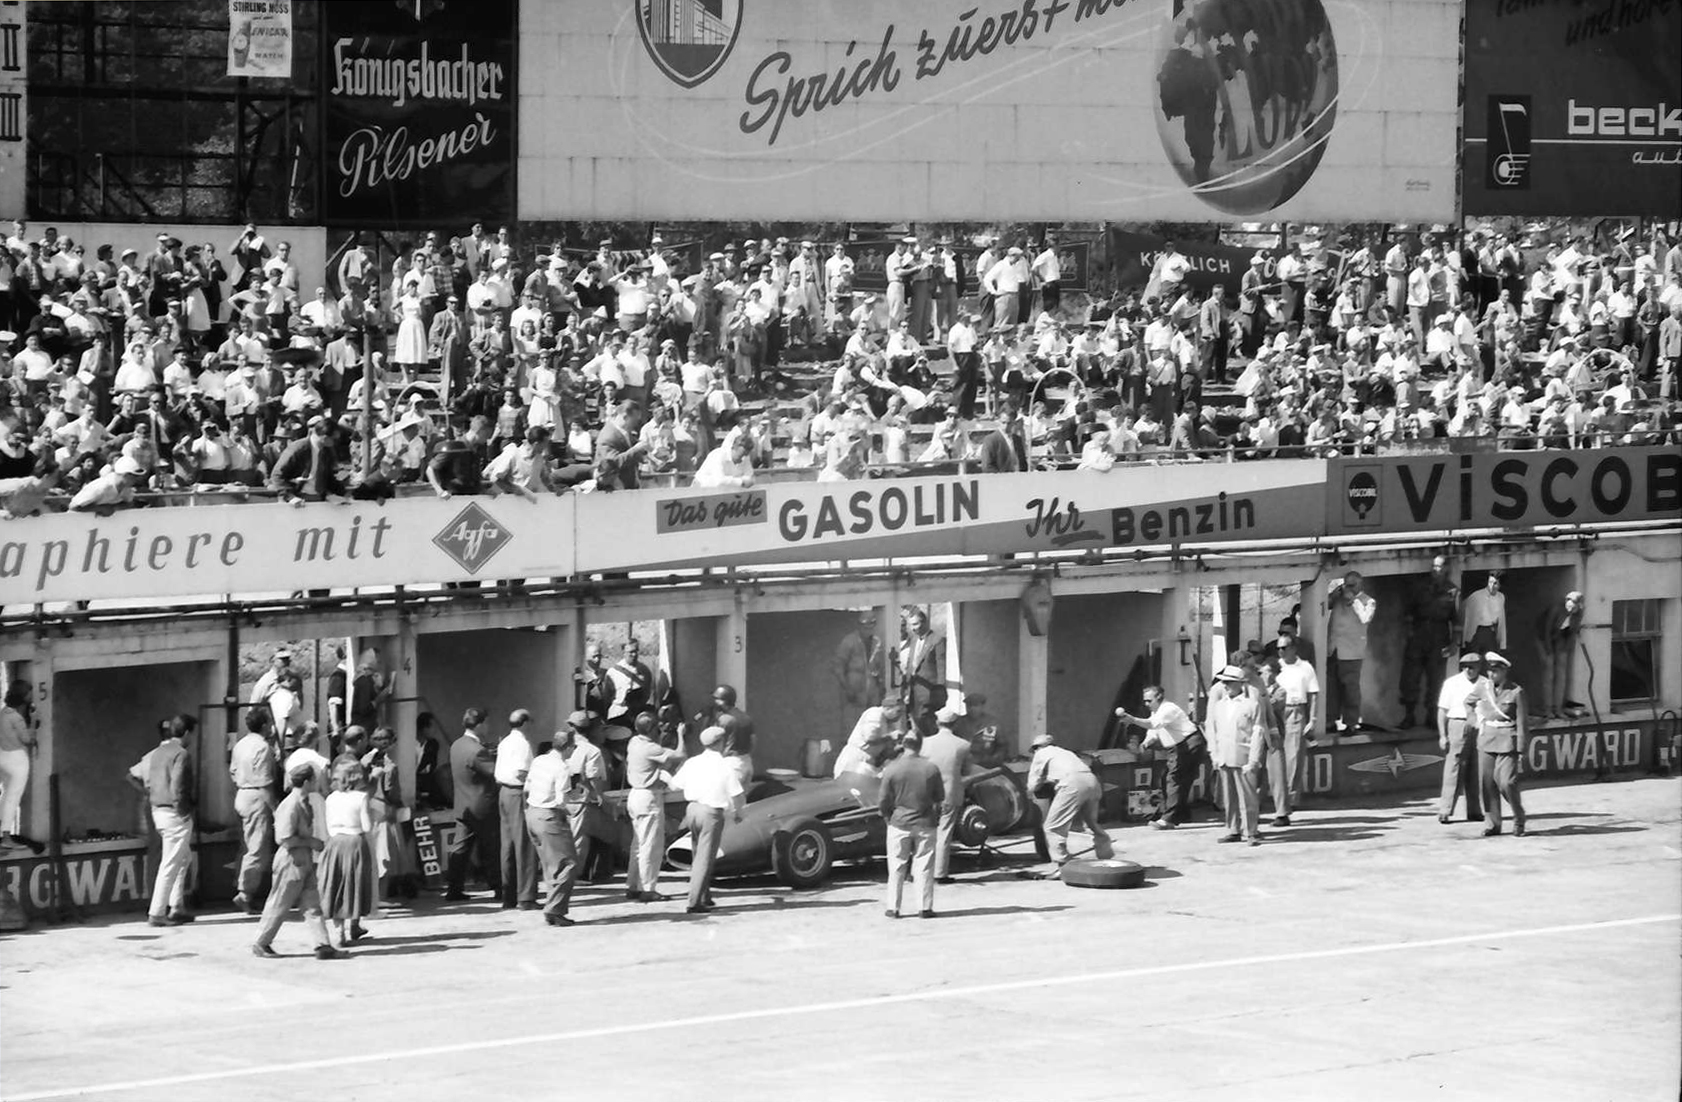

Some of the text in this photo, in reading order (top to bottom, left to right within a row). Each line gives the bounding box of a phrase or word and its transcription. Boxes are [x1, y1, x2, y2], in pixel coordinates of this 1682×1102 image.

[740, 24, 900, 146] Sprich
[339, 112, 497, 198] Pilsener
[664, 501, 707, 526] Das
[779, 480, 979, 542] GASOLIN
[1026, 491, 1255, 545] Ihr Benzin
[0, 515, 499, 592] aphiere mit Agfa
[39, 681, 48, 701] 5
[413, 816, 442, 876] BEHR
